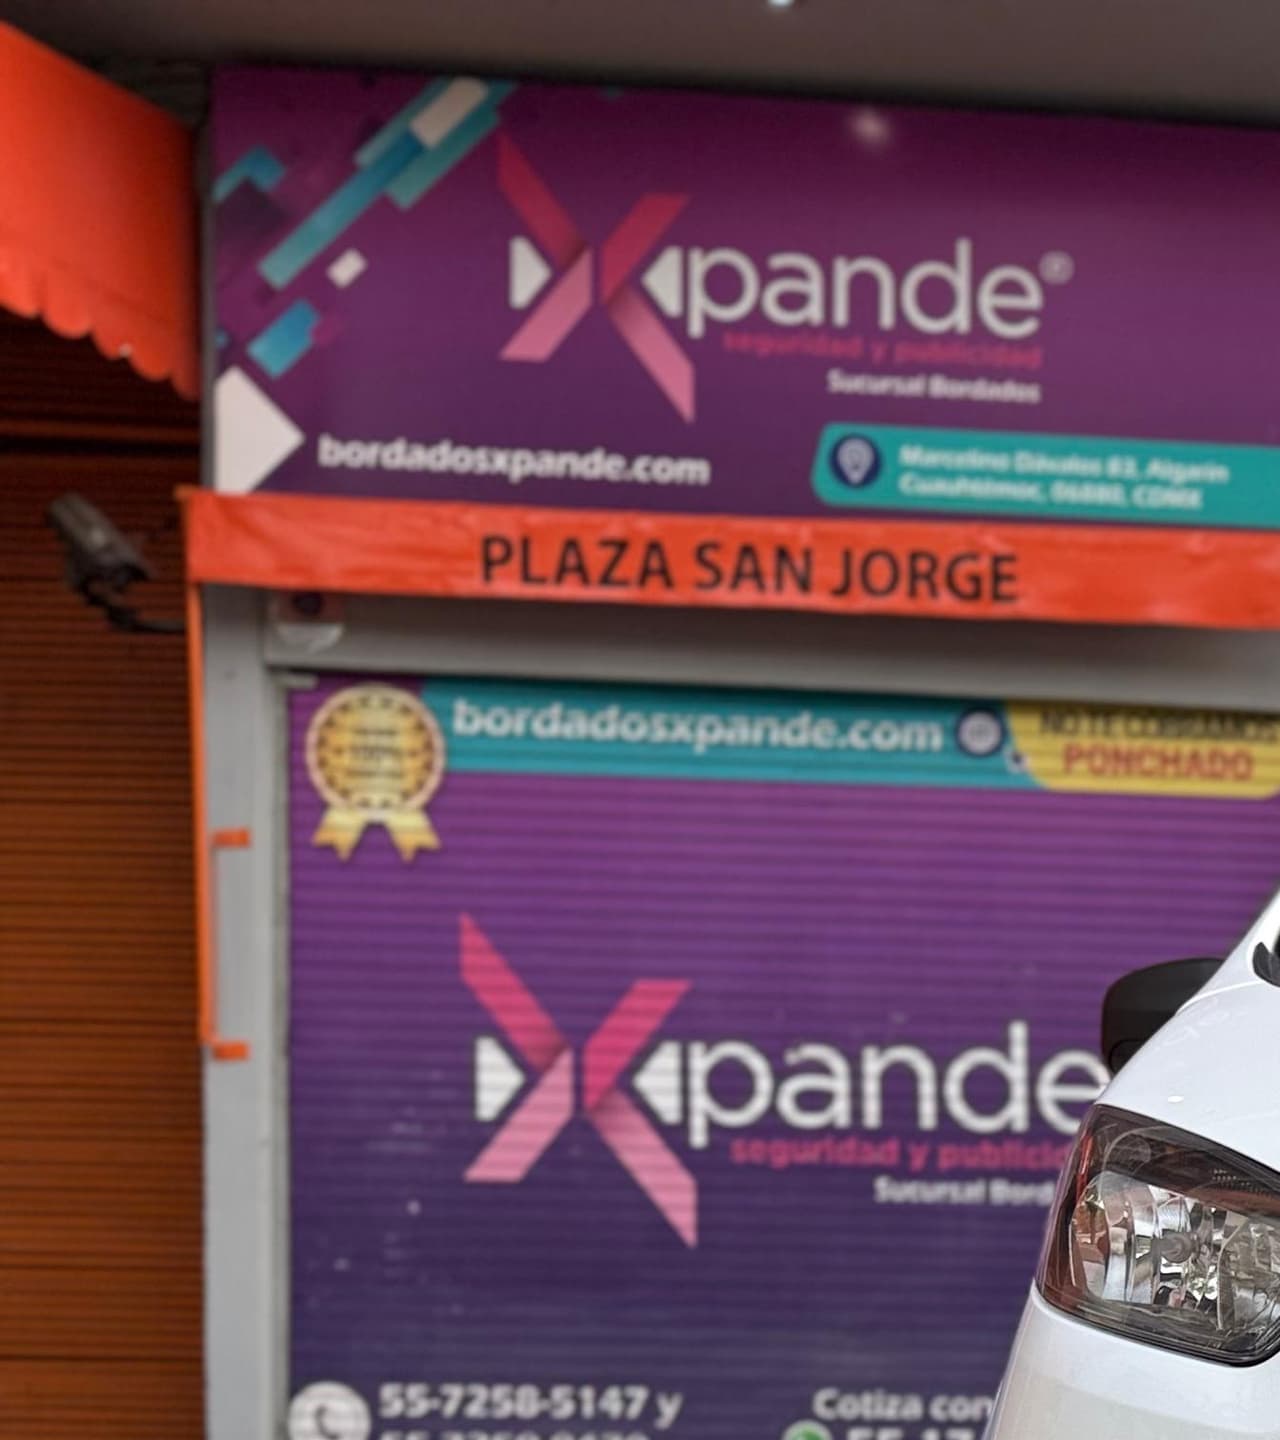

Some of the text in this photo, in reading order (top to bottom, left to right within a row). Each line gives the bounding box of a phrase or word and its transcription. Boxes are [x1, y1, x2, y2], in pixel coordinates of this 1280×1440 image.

[827, 368, 1040, 404] Sucursal Bordados
[318, 433, 711, 487] bordadosxpande.com
[481, 534, 1019, 604] PLAZA SAN JORGE
[452, 697, 944, 755] bordadosxpande.com
[729, 1136, 1072, 1174] seguridad y publicid
[873, 1174, 1057, 1206] Sucursal Bord
[378, 1382, 684, 1432] 55-7258-5147 y
[813, 1387, 924, 1422] Cotiza
